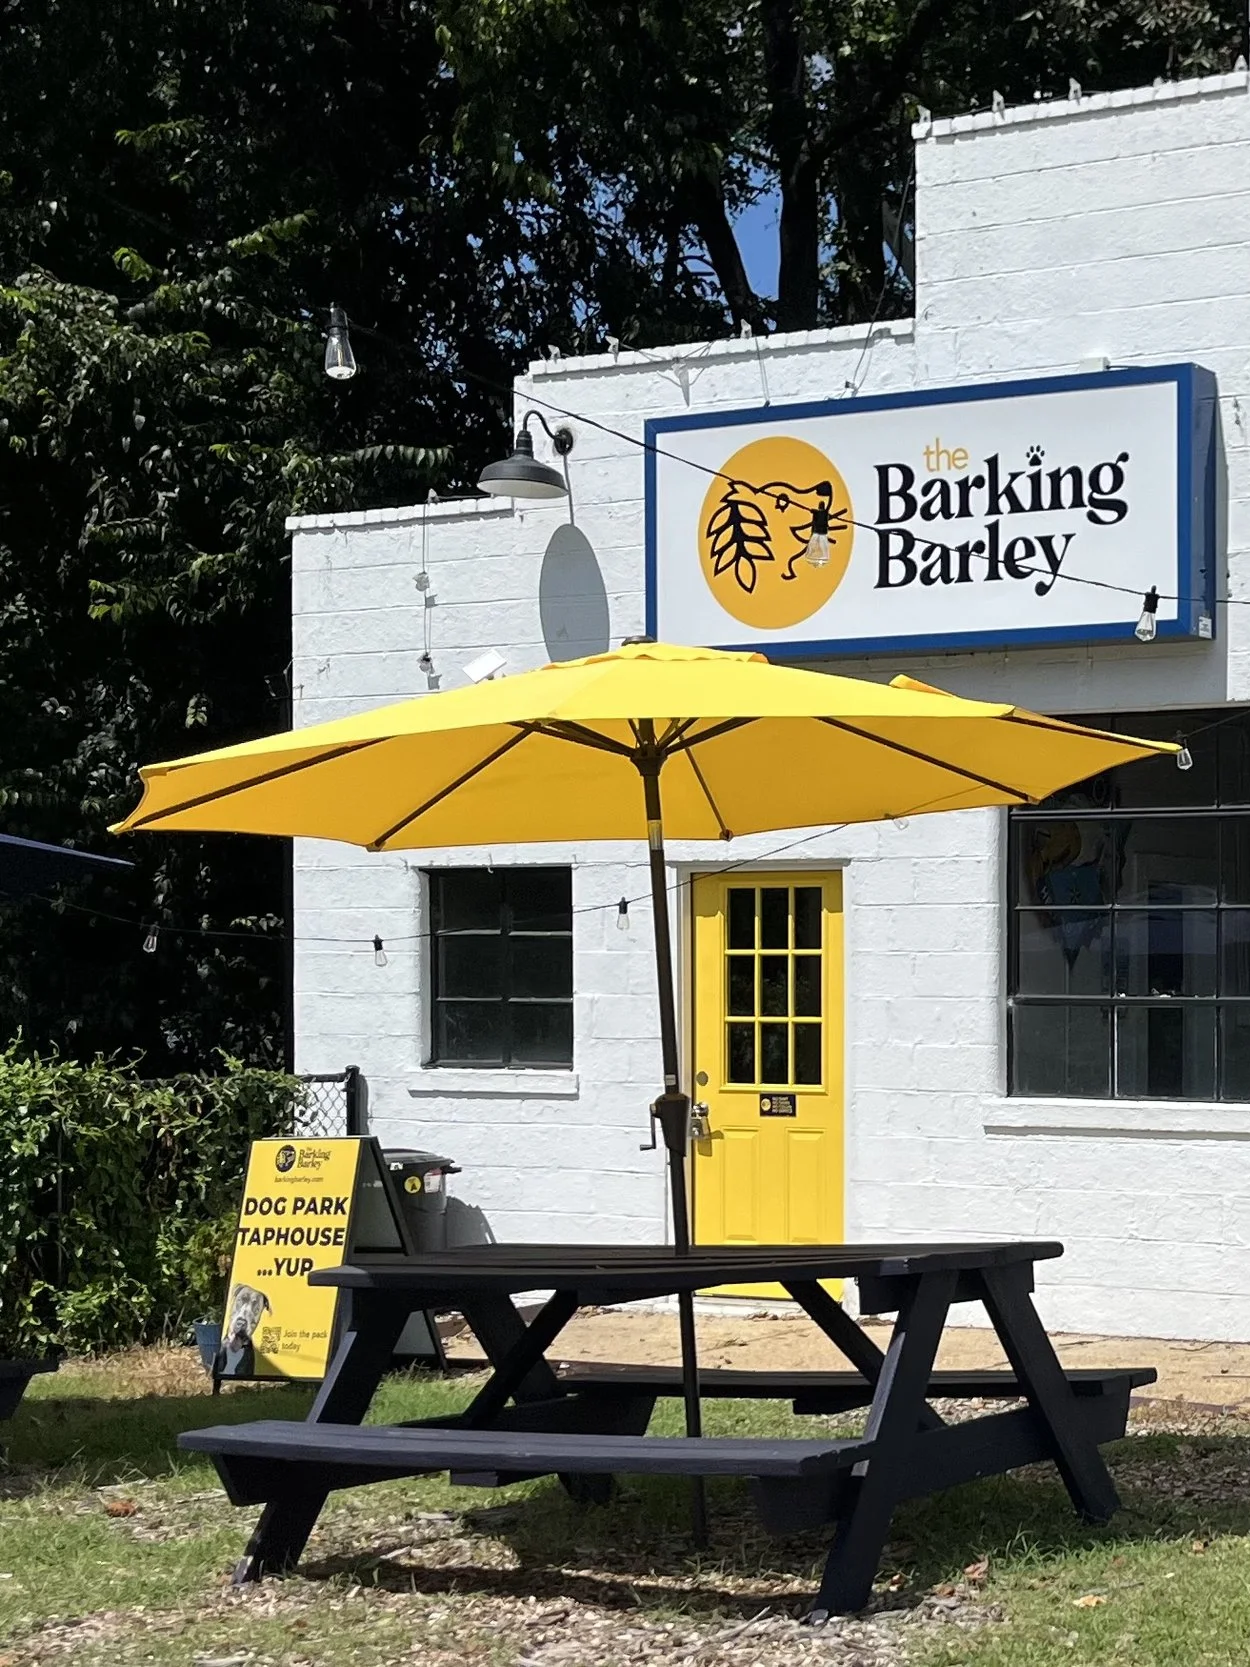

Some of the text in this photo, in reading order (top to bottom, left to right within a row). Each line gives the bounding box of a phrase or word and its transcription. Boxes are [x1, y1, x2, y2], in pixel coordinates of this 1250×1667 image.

[923, 438, 968, 472] the
[874, 446, 1130, 525] Barking
[874, 519, 1076, 597] Barley
[244, 1197, 349, 1216] DOG PARK
[239, 1227, 345, 1246] TAPHOUSE
[283, 1329, 327, 1340] Join the pack
[281, 1341, 301, 1352] today
